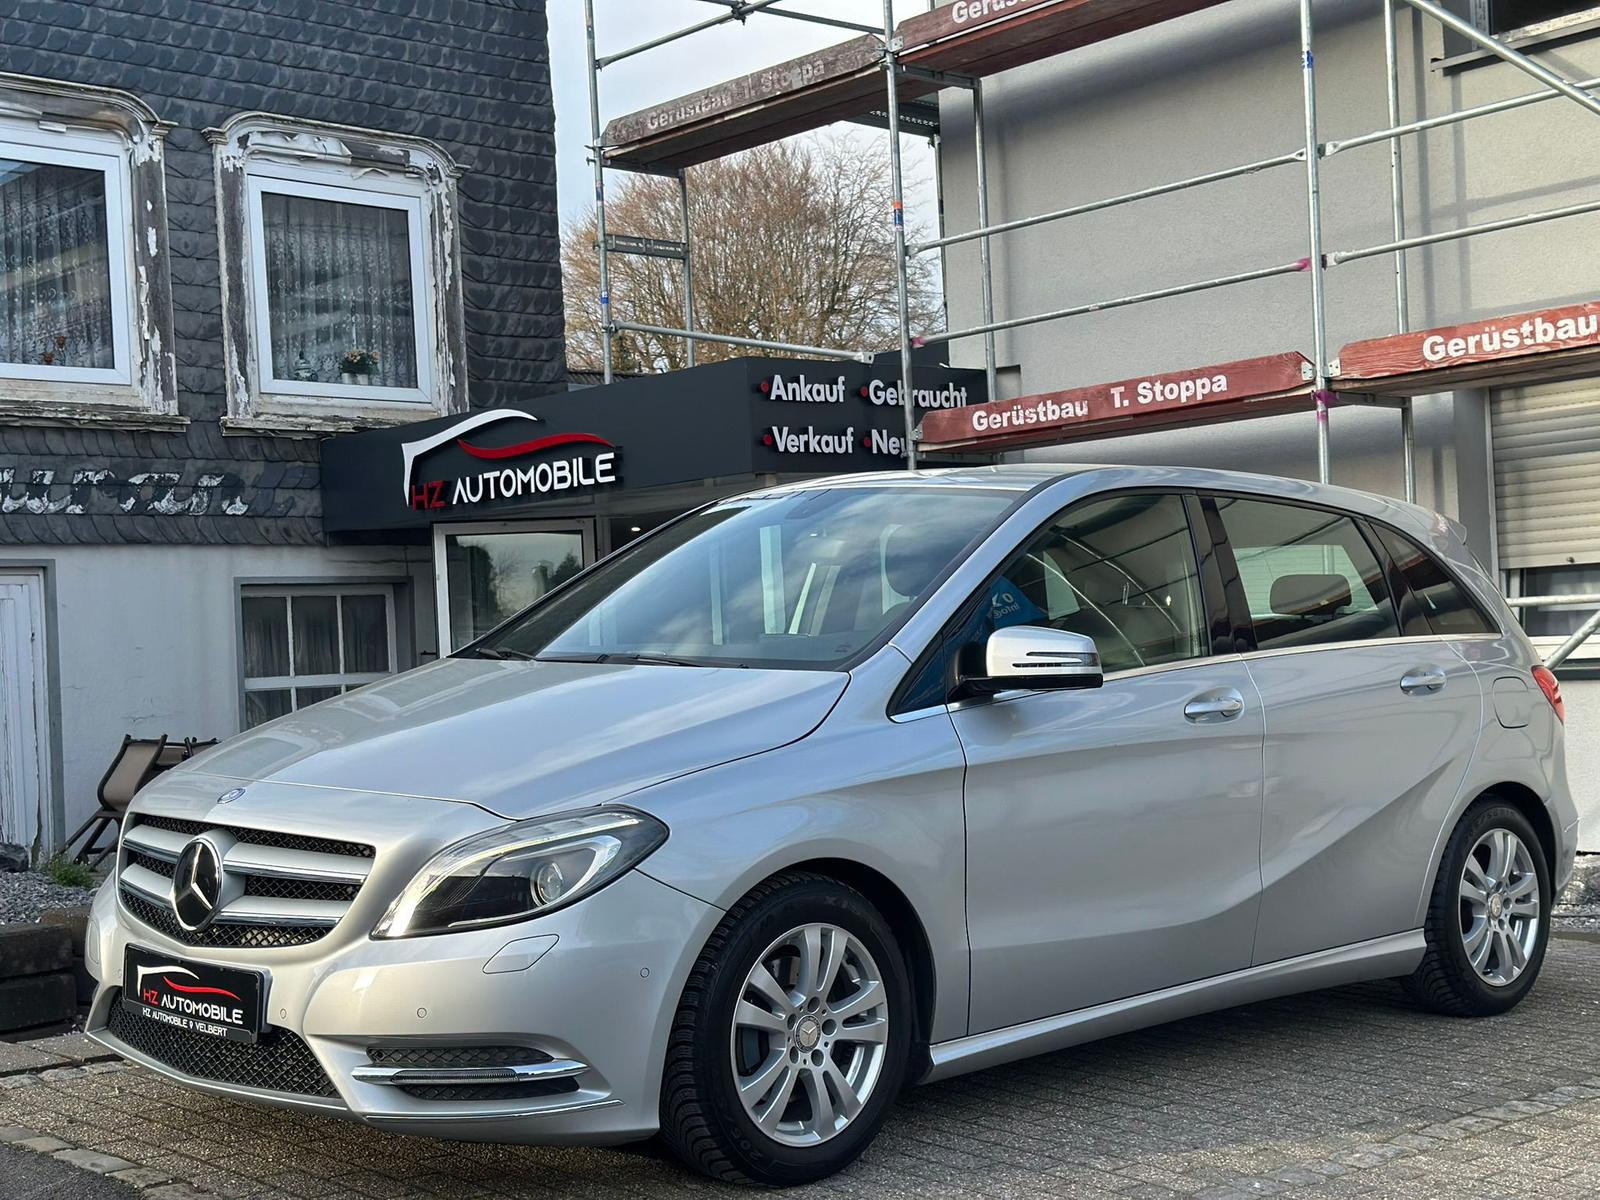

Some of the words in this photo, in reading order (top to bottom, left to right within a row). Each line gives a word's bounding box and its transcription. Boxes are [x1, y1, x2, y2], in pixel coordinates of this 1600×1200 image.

[1422, 314, 1598, 362] Gerüstbau
[770, 374, 845, 403] Ankauf
[868, 379, 968, 408] Gebraucht
[972, 399, 1089, 431] Gerüstbau
[1110, 386, 1129, 409] T.
[1137, 374, 1228, 404] Stoppa
[772, 426, 854, 453] Verkauf
[411, 480, 447, 511] HZ
[452, 452, 616, 505] AUTOMOBILE
[142, 1007, 151, 1018] HZ
[152, 1012, 188, 1029] AUTOMOBILE
[195, 1021, 228, 1037] VELBERT
[143, 988, 159, 1005] HZ
[161, 994, 244, 1025] AUTOMOBILE
